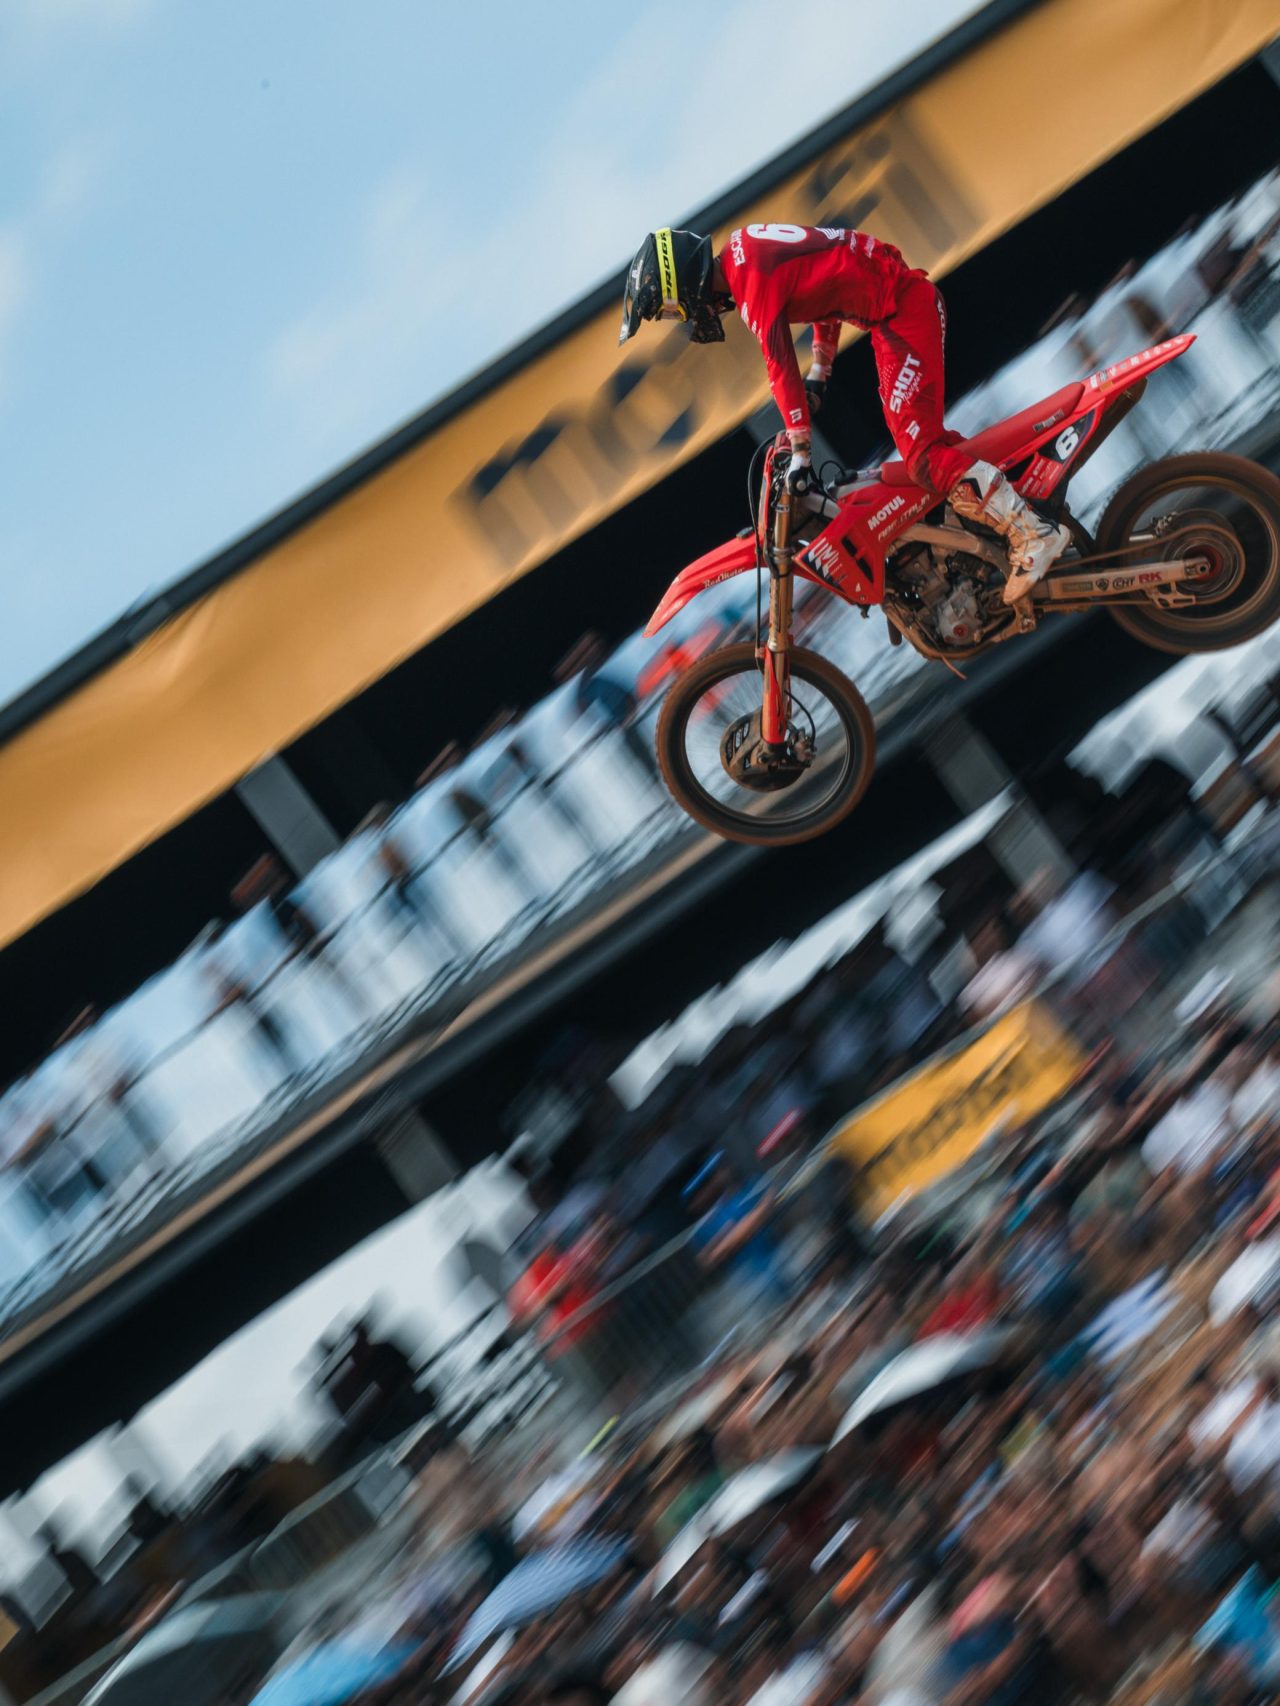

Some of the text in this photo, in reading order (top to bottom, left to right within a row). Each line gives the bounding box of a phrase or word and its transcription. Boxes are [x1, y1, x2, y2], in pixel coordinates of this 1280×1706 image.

[747, 223, 807, 243] 6
[890, 353, 921, 414] SHOT
[1056, 426, 1078, 460] 6
[867, 495, 905, 531] MOTUL
[1138, 571, 1162, 584] RK
